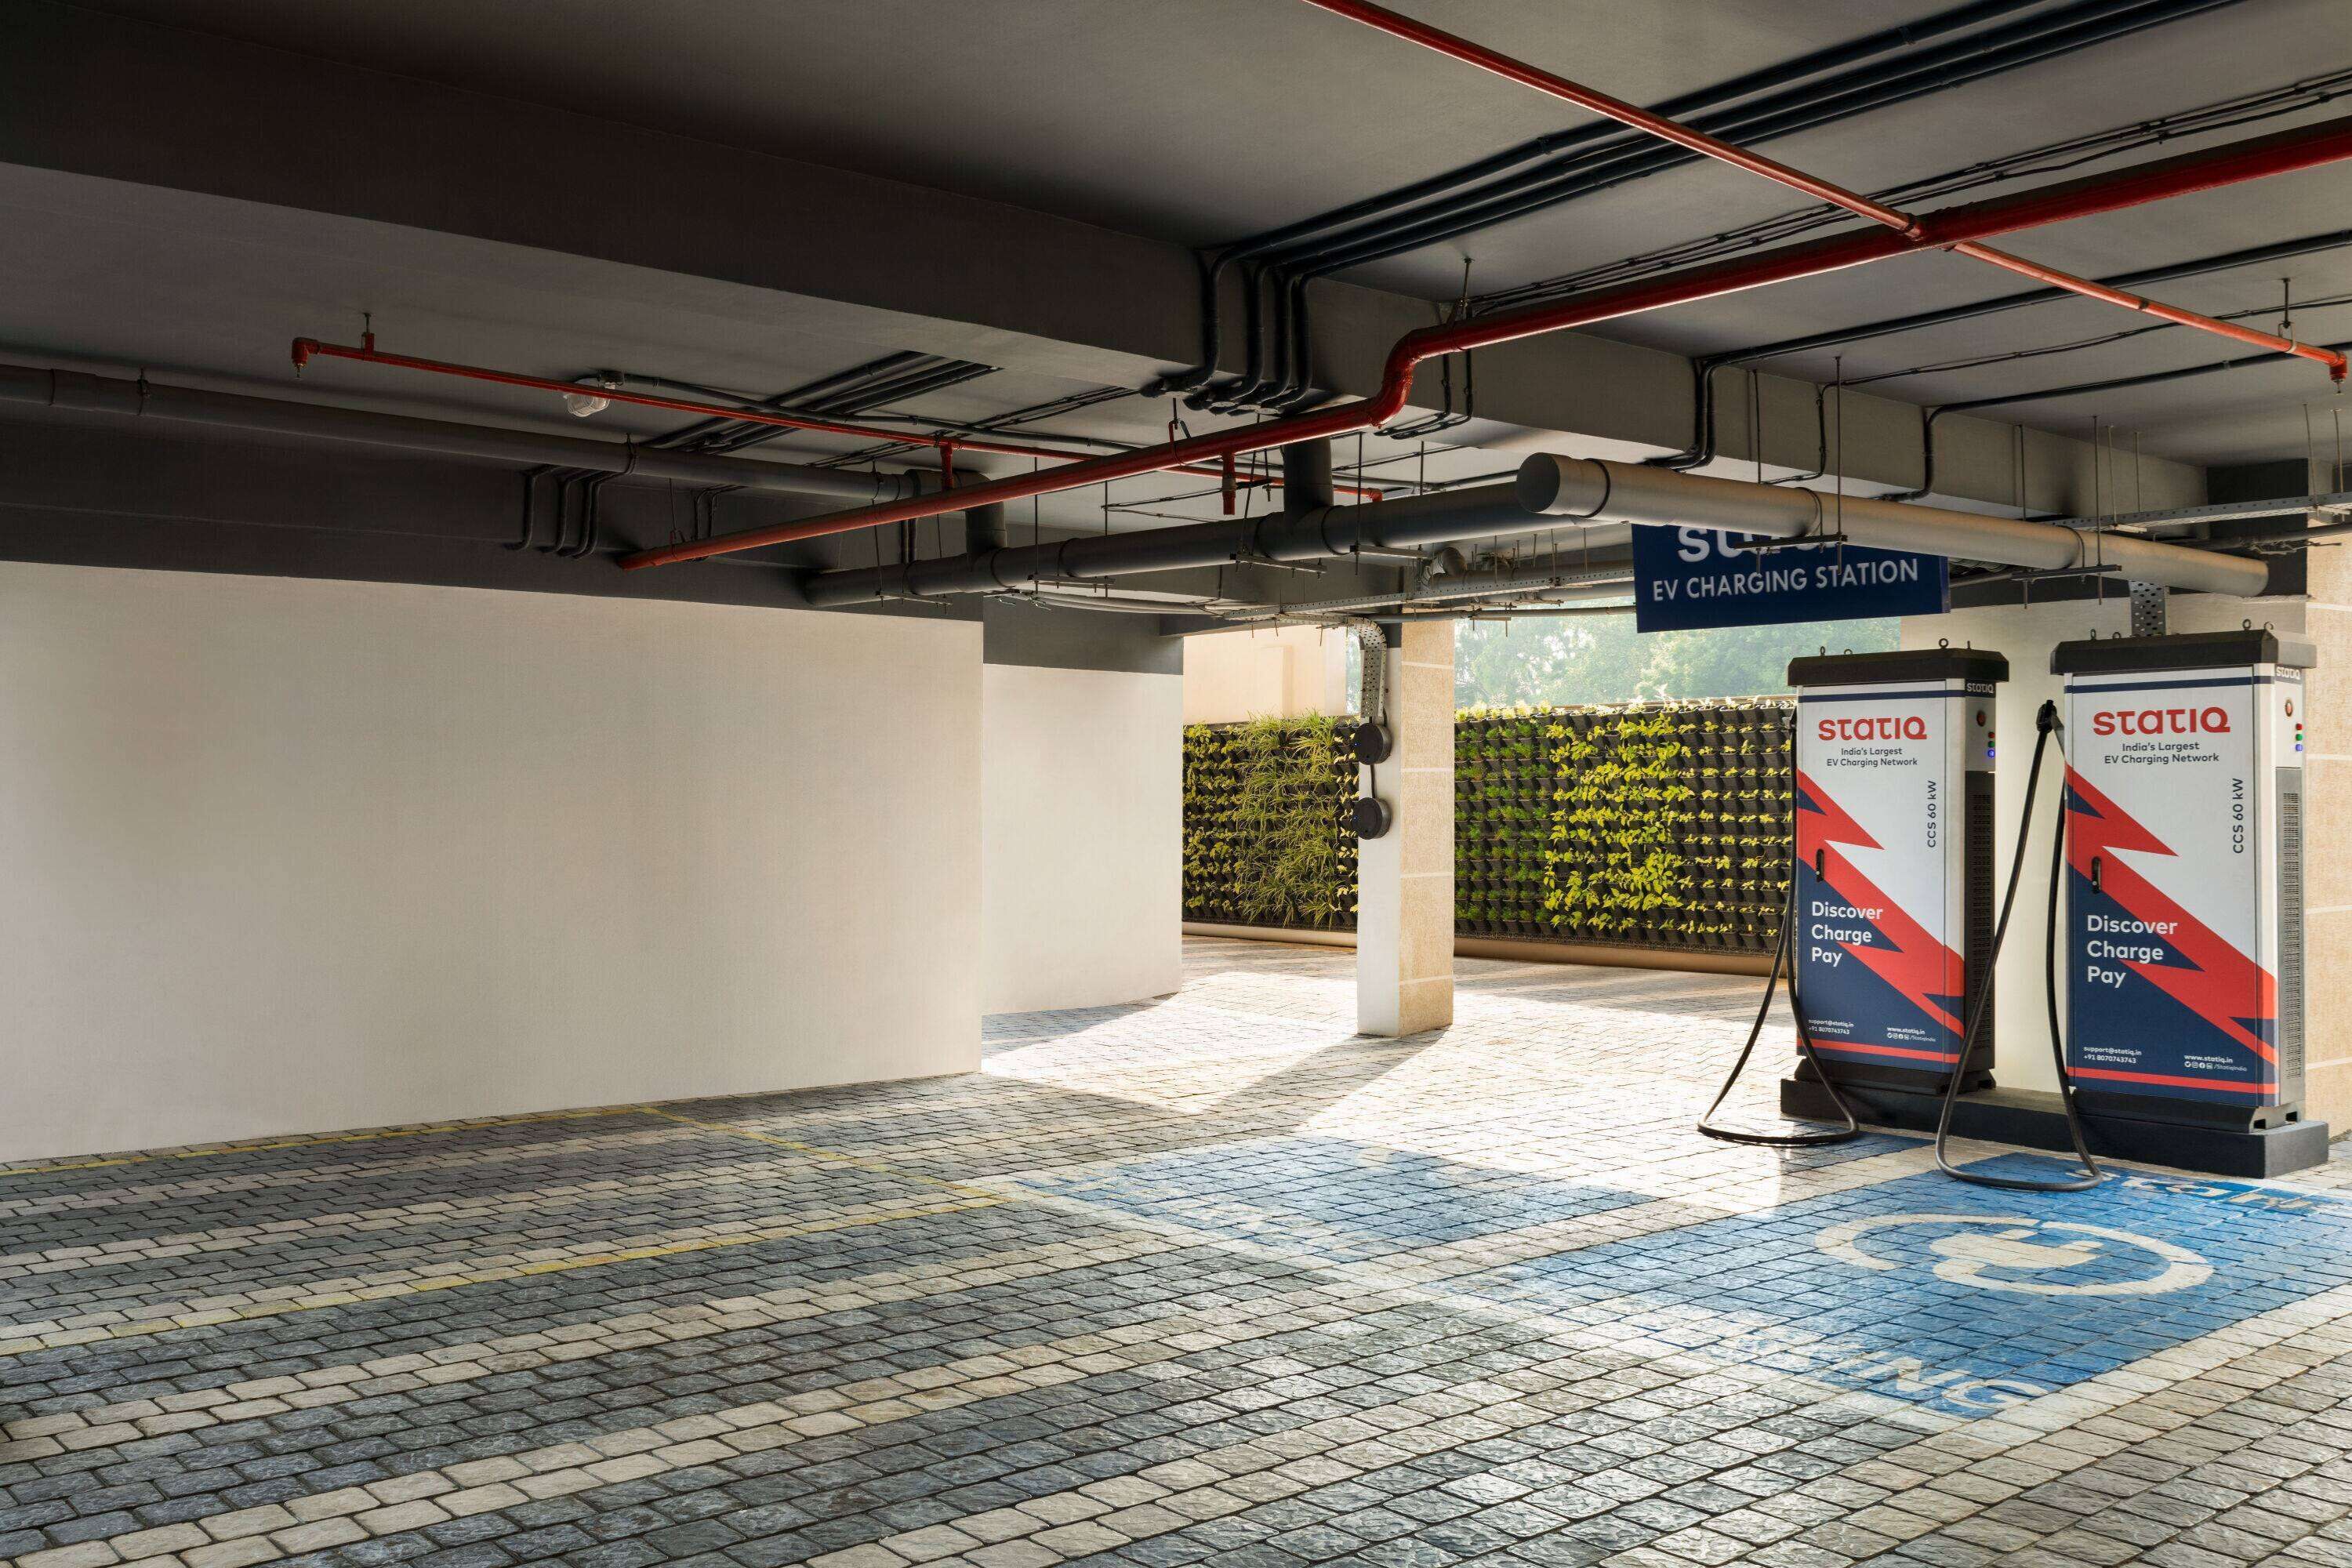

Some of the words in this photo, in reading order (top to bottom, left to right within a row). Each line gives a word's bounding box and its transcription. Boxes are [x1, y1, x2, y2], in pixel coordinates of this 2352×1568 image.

[1653, 579, 1679, 601] EV
[1686, 568, 1807, 599] CHARGING
[1816, 558, 1918, 589] STATION
[1869, 747, 1903, 757] Largest
[2122, 742, 2156, 753] India's
[2158, 742, 2200, 754] Largest
[1827, 758, 1838, 767] EV
[1840, 758, 1878, 768] Charging
[2104, 755, 2119, 764] EV
[2122, 754, 2169, 765] Charging
[2172, 753, 2220, 763] Network
[1927, 780, 1936, 800] kW
[2232, 778, 2244, 799] kW
[1927, 803, 1936, 818] 60
[2232, 804, 2244, 822] 60
[1927, 822, 1936, 848] CCS
[2232, 825, 2244, 854] CCS
[1812, 901, 1883, 920] Discover
[2087, 914, 2178, 935] Discover
[1811, 924, 1872, 946] Charge
[1812, 947, 1842, 967] Pay
[2087, 940, 2164, 964] Charge
[2087, 966, 2126, 988] Pay
[2083, 1047, 2142, 1055] support@statiq.in
[2096, 1055, 2136, 1064] 8070743743
[2184, 1055, 2233, 1064] www.statiq.in
